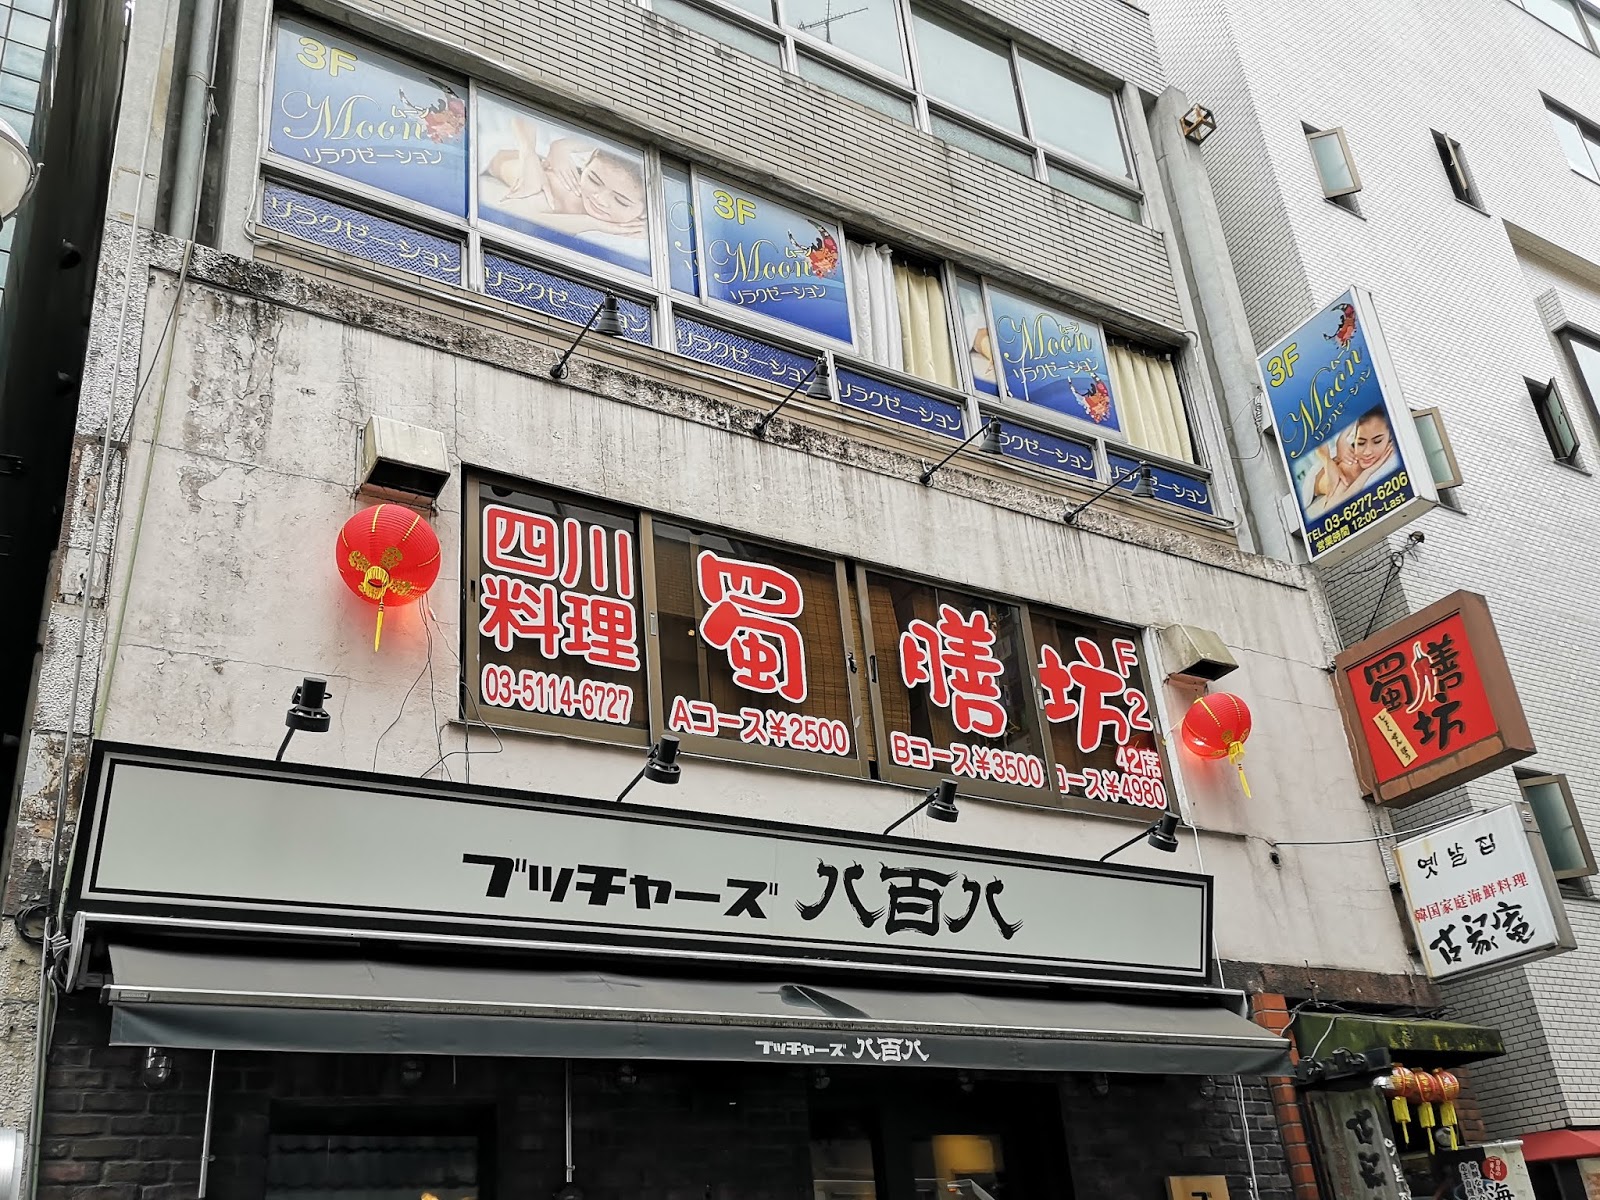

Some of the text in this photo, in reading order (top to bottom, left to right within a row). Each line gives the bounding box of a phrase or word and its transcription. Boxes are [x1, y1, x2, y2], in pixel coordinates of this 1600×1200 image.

[297, 37, 358, 77] 3F
[281, 90, 427, 142] Moon
[304, 146, 443, 166] リラクゼーション
[712, 188, 757, 225] 3F
[272, 196, 460, 272] リラクゼーション
[709, 239, 812, 284] Moon
[729, 285, 826, 305] リラクゼーション
[996, 313, 1092, 364] Moon
[1013, 357, 1099, 384] リラクゼーション
[1267, 343, 1300, 388] 3F
[1281, 347, 1363, 459] Moon
[984, 427, 1093, 470] ラクゼーション
[483, 503, 634, 599] 四川
[480, 575, 641, 671] 料理
[481, 662, 634, 725] 03-5114-6727
[668, 695, 850, 757] Aコース¥2500
[890, 730, 1044, 788] Bコース¥3500
[1115, 746, 1162, 780] 42席
[462, 852, 1024, 941] ブッチャーズ 八百八
[1413, 871, 1529, 924] 韓国家庭海鮮料理
[755, 1037, 930, 1062] ブッチャーズ 八百八
